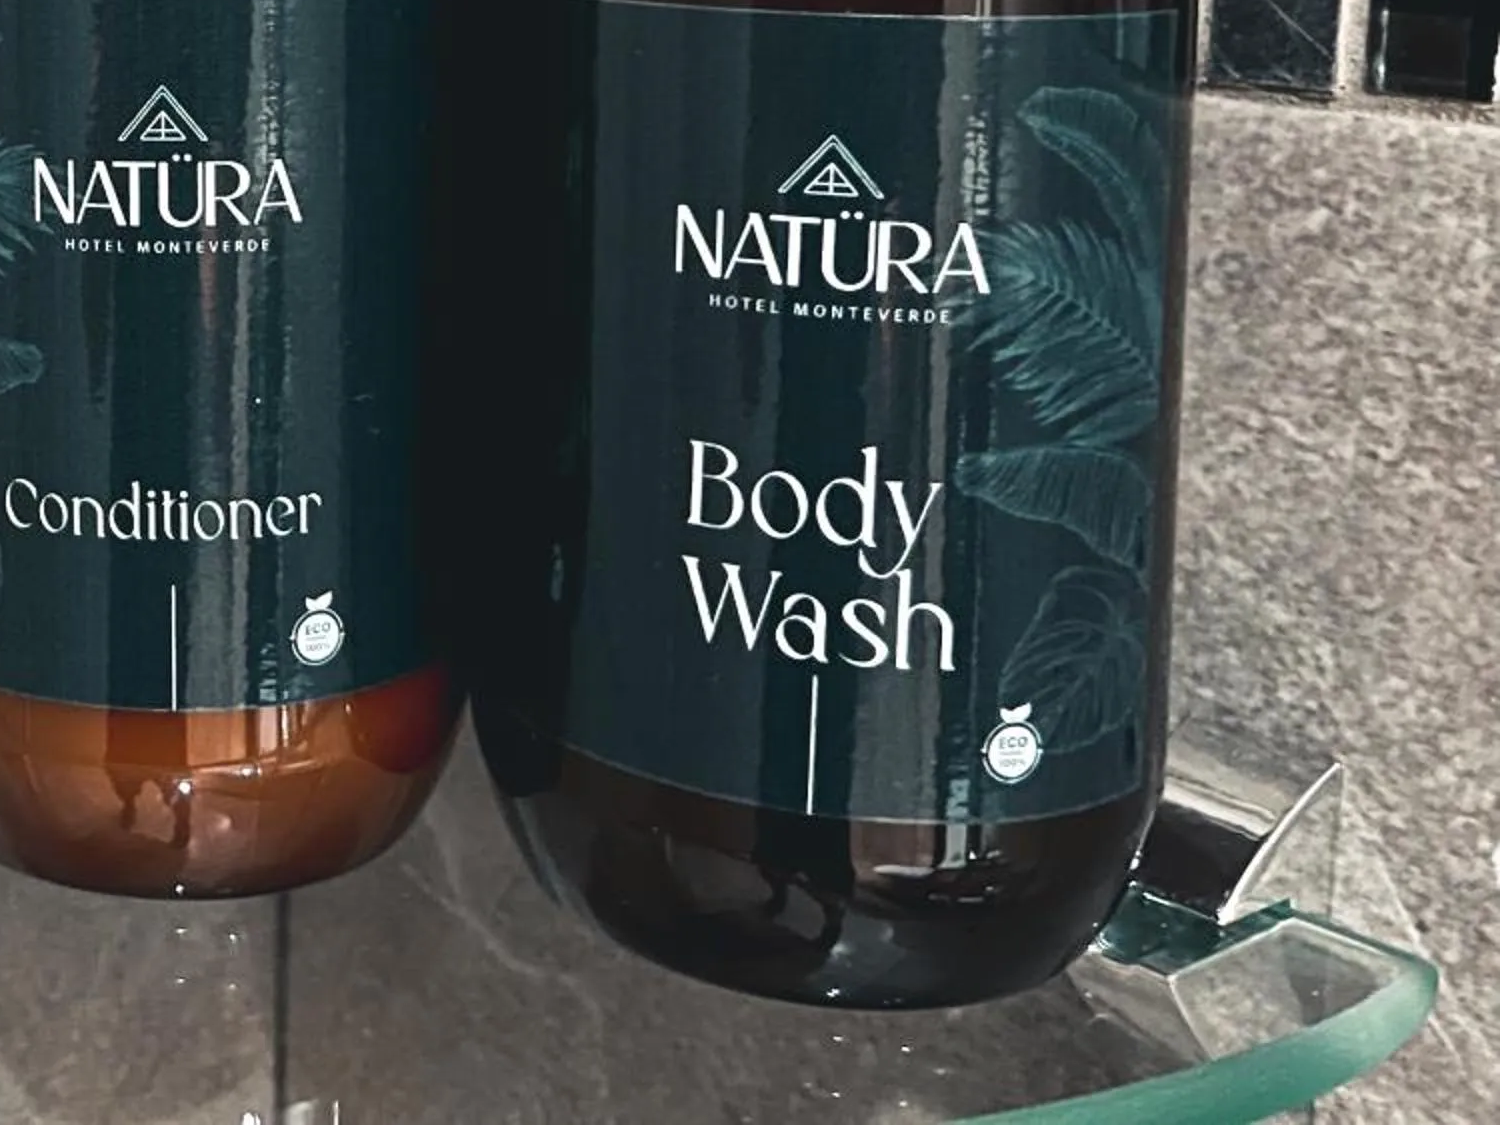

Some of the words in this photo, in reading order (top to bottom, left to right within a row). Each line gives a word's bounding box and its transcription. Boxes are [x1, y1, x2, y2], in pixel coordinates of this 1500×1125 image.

[33, 153, 303, 228] NATÜRA
[65, 238, 125, 253] HOTEL
[137, 238, 270, 254] MONTEVERDE
[675, 204, 991, 294] NATÜRA
[709, 294, 780, 314] HOTEL
[793, 303, 951, 325] MONTEVERDE
[4, 478, 322, 541] Conditioner
[686, 439, 944, 579] Body
[305, 622, 331, 635] ECO
[681, 555, 956, 672] Wash
[999, 736, 1028, 749] ECO
